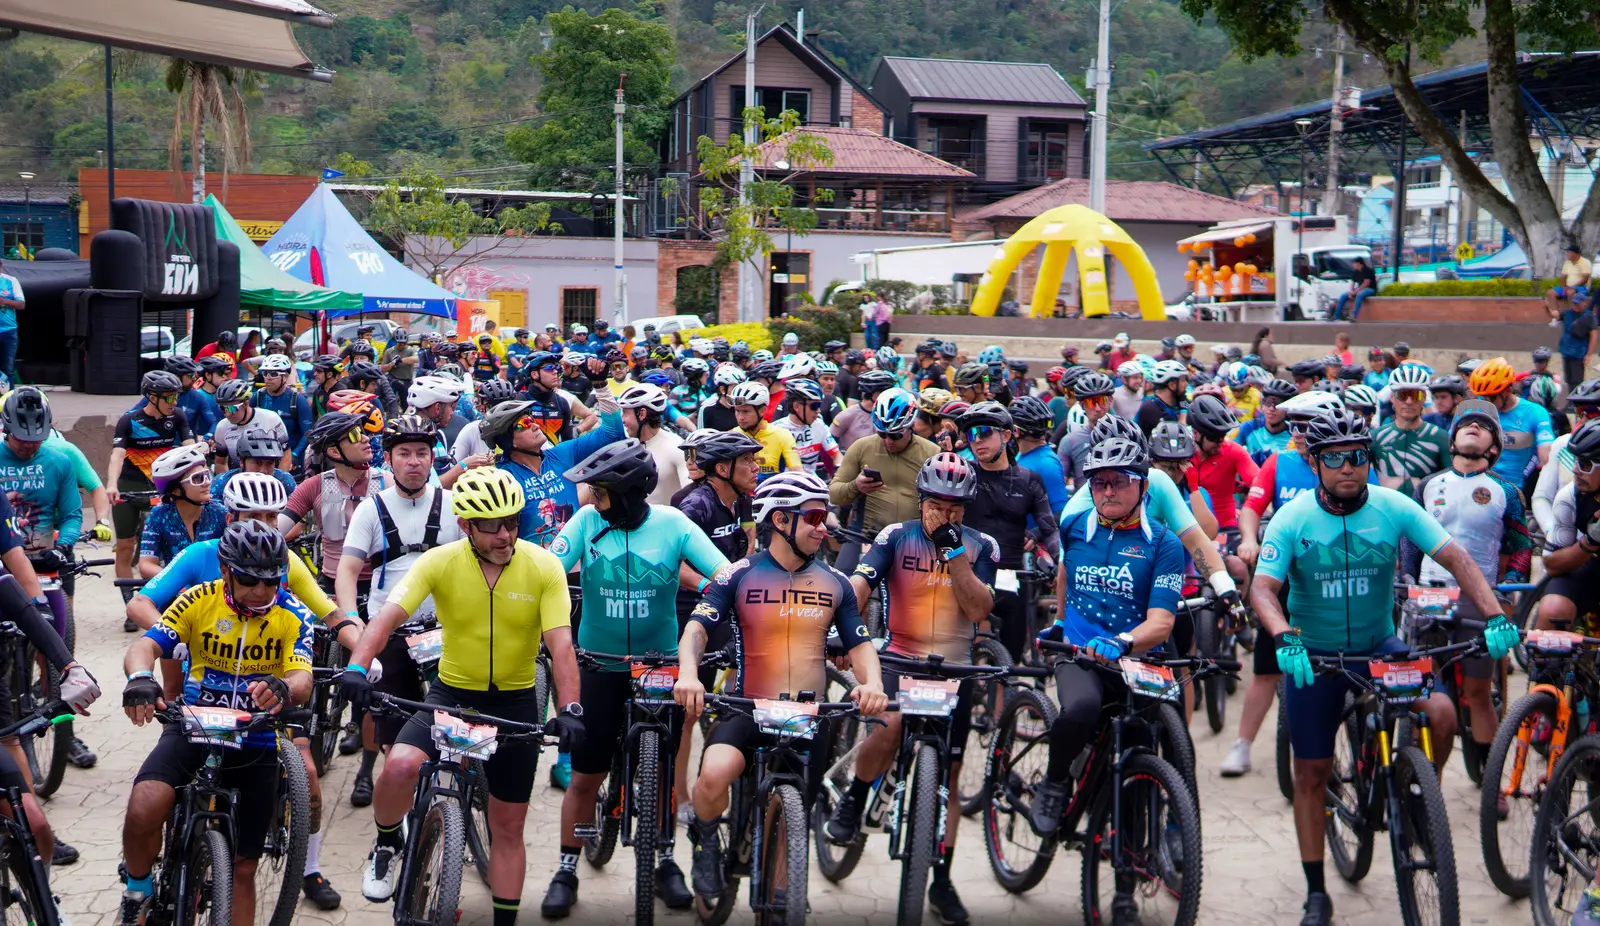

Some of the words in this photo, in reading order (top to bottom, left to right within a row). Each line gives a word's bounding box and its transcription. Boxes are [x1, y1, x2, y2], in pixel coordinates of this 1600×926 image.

[348, 252, 384, 275] TAO
[0, 464, 44, 476] NEVER
[525, 470, 558, 488] NEVER
[23, 480, 45, 489] MAN
[528, 490, 546, 500] OLD
[548, 482, 565, 496] MAN
[1076, 562, 1134, 581] BOGOTÁ
[1314, 572, 1331, 580] San
[1333, 568, 1378, 577] Francisco
[1075, 573, 1134, 592] MEJOR
[1075, 583, 1100, 592] PARA
[1321, 577, 1369, 598] MTB
[600, 587, 614, 597] San
[616, 589, 656, 598] Francisco
[745, 589, 833, 608] ELITES
[162, 581, 217, 625] Tinkoff
[606, 598, 650, 618] MTB
[779, 606, 793, 617] LA
[797, 608, 824, 620] VEGA
[201, 632, 282, 660] Tinkoff
[200, 649, 229, 669] Credit
[204, 673, 250, 688] SAX
[1383, 670, 1422, 687] 062
